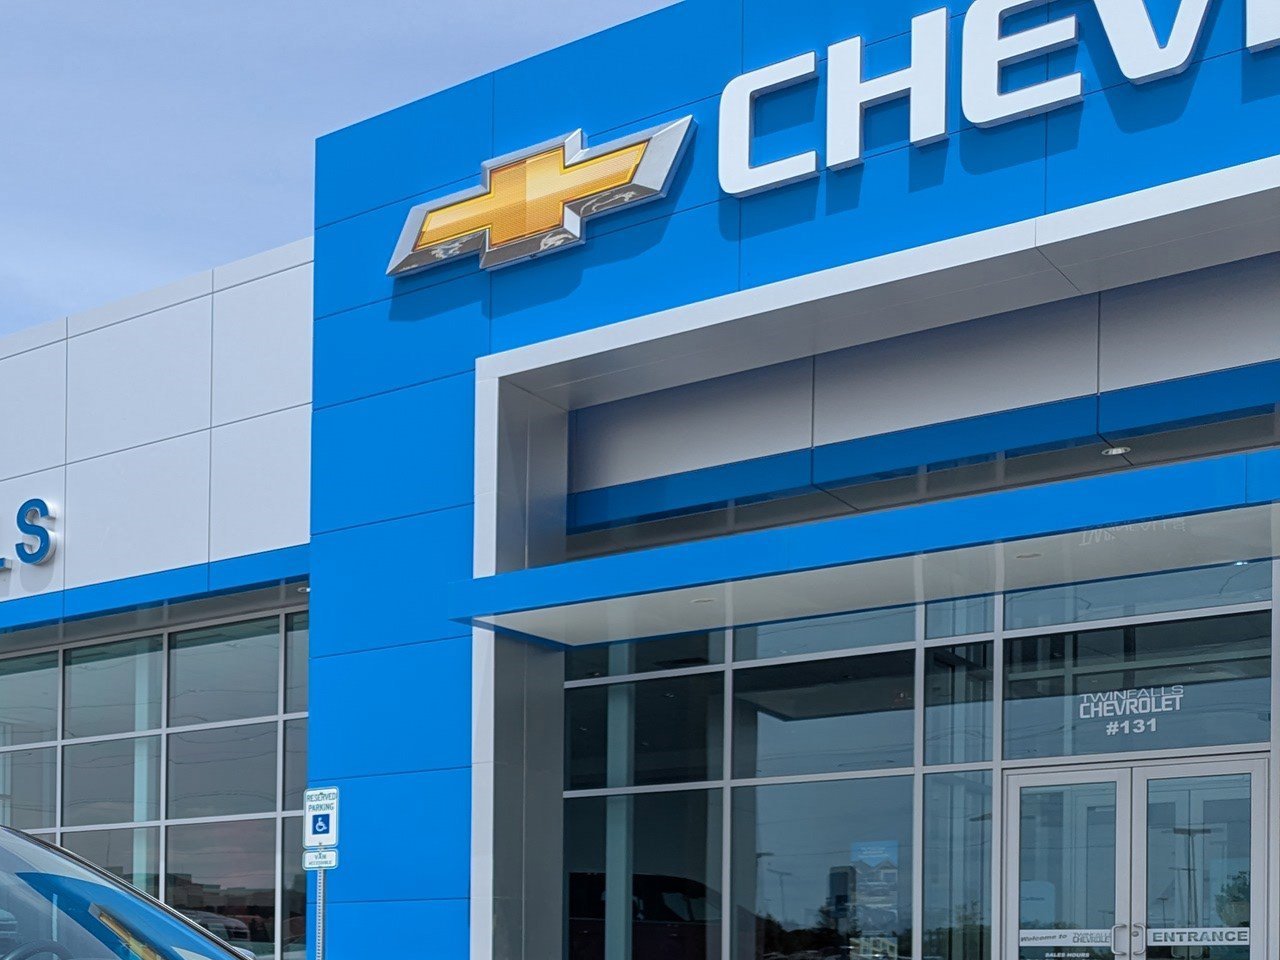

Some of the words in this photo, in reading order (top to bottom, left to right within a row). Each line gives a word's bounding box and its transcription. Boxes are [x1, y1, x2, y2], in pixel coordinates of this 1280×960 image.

[1080, 685, 1184, 703] TWINFALLS
[1080, 694, 1184, 719] CHEVROLET
[1106, 718, 1157, 735] #131
[307, 791, 337, 802] RESERVED
[308, 802, 334, 812] PARKING
[1153, 931, 1248, 942] ENTRANCE
